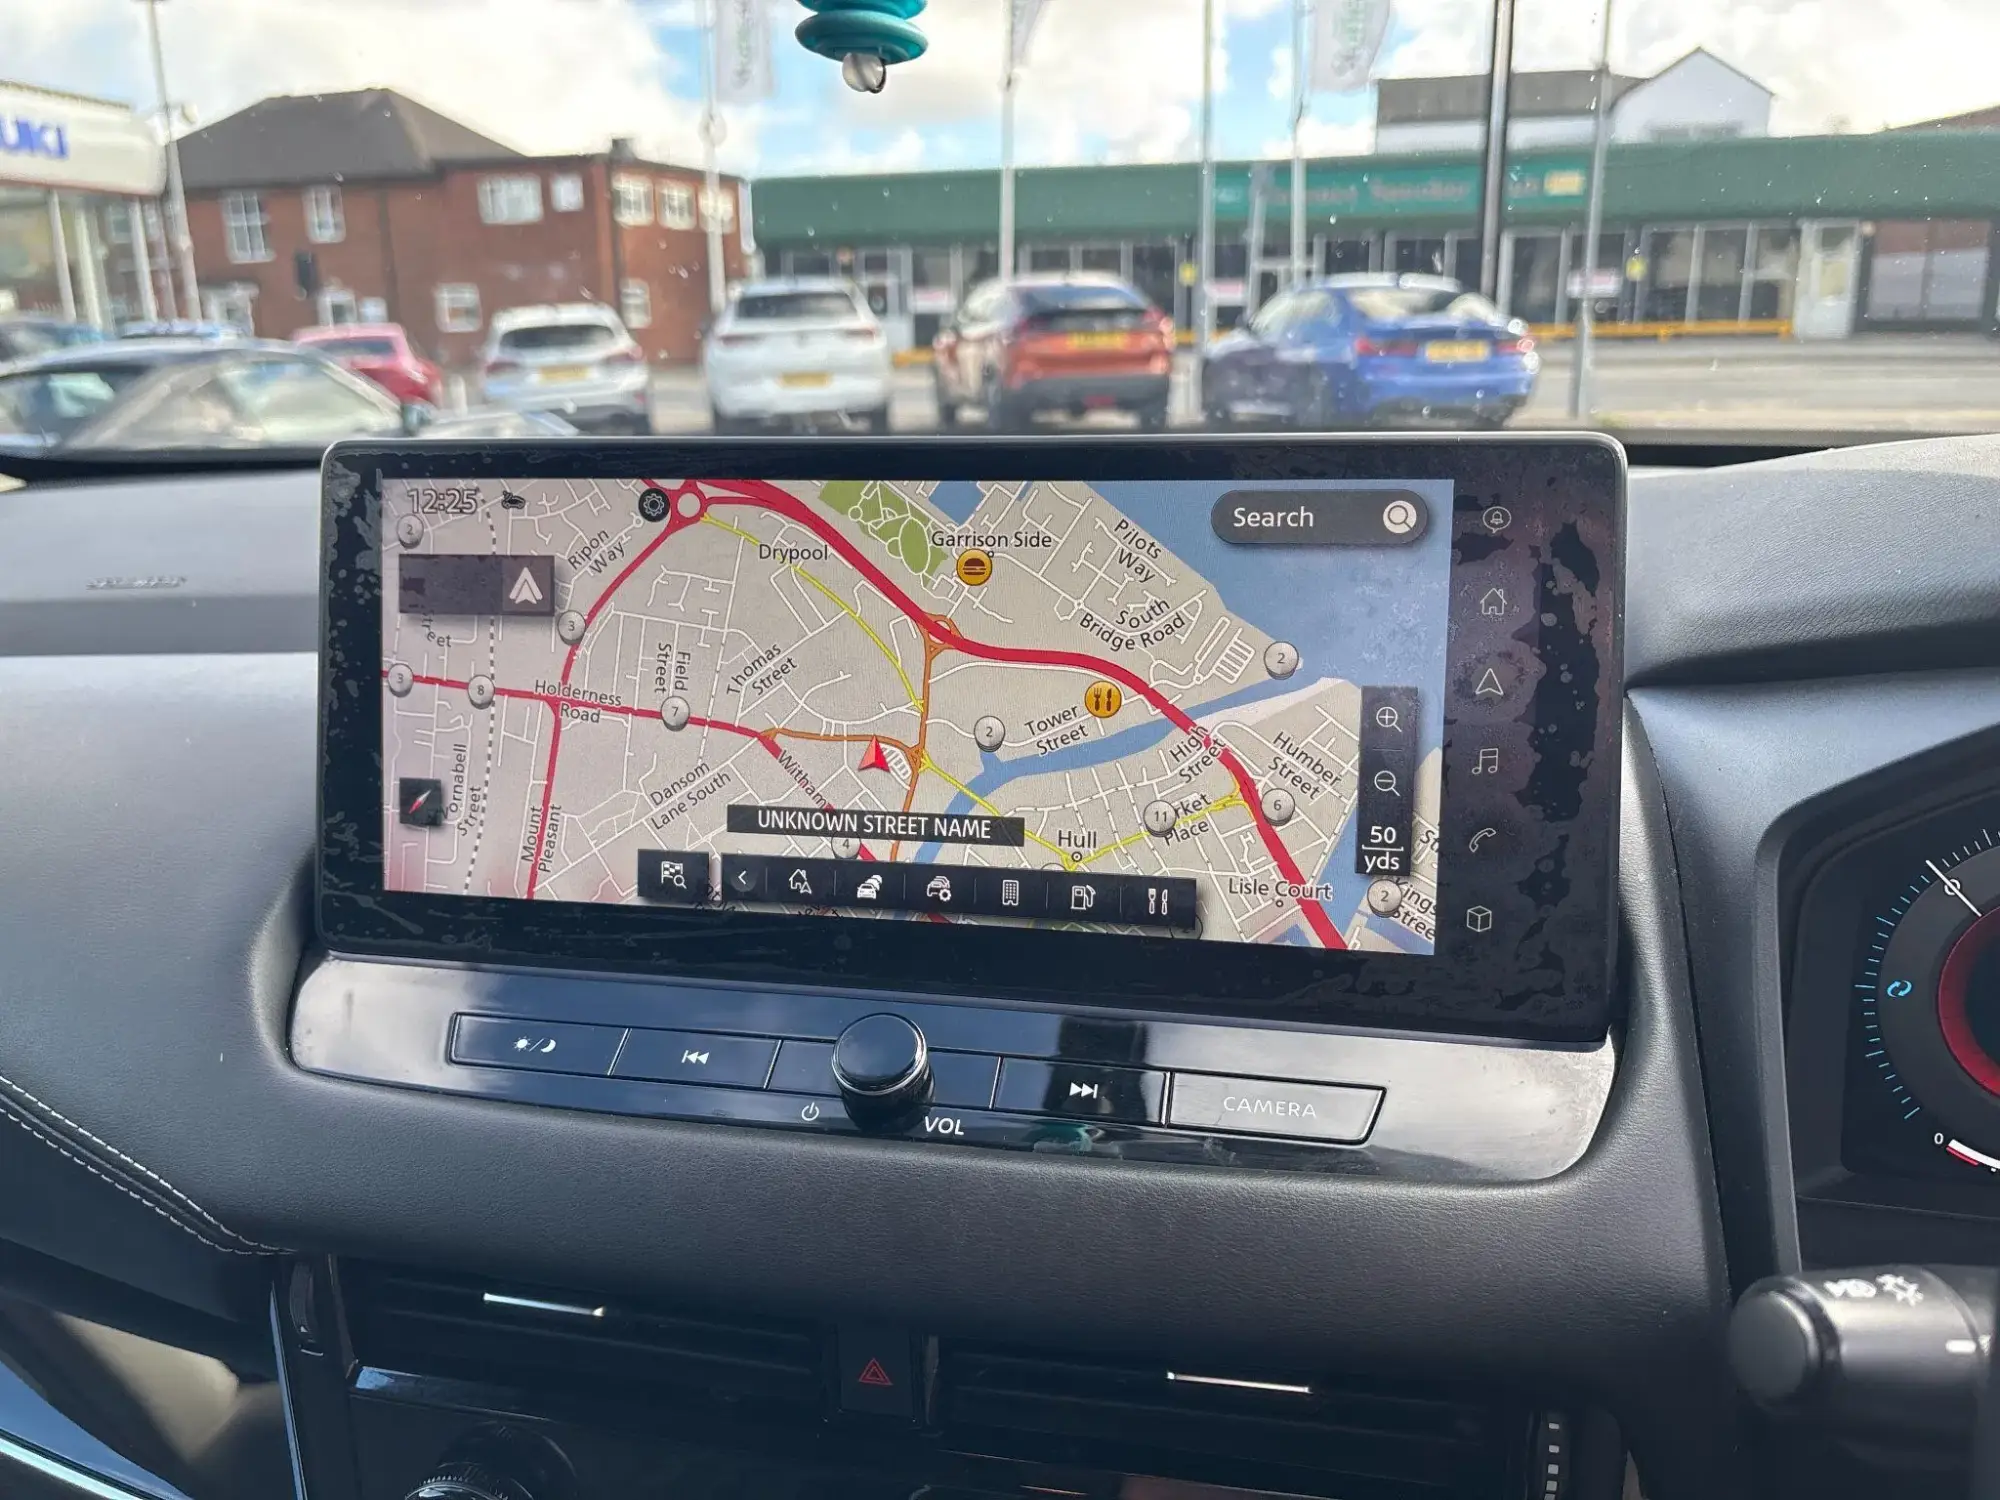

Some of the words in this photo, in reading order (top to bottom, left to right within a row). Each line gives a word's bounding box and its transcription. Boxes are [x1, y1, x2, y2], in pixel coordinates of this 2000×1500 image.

[407, 488, 477, 515] 12:25
[1233, 506, 1314, 527] Search
[568, 530, 609, 570] Ripon
[932, 530, 1008, 547] Garrison
[1014, 531, 1052, 547] Side
[1114, 519, 1162, 559] Pilots
[589, 542, 625, 574] Way
[759, 543, 828, 564] Drypool
[1117, 548, 1156, 583] Way
[568, 620, 575, 631] 3
[1115, 599, 1170, 629] South
[1080, 612, 1136, 652] Bridge
[1140, 612, 1185, 648] Road
[654, 643, 672, 694] Street
[674, 651, 691, 691] Field
[726, 644, 781, 695] Thomas
[1277, 652, 1285, 664] 2
[752, 657, 798, 695] Street
[535, 679, 622, 706] Holderness
[561, 703, 601, 723] Road
[672, 706, 679, 717] 7
[1024, 706, 1078, 736] Tower
[986, 726, 993, 737] 2
[1036, 724, 1089, 755] Street
[1169, 726, 1209, 763] High
[1179, 738, 1227, 784] Street
[1273, 731, 1342, 786] Humber
[650, 762, 710, 806] Dansom
[1268, 756, 1321, 800] Street
[457, 785, 482, 836] Street
[651, 802, 688, 830] Lane
[687, 772, 731, 806] South
[1274, 800, 1281, 811] 6
[758, 810, 857, 832] UNKNOWN
[863, 814, 928, 836] STREET
[934, 818, 991, 839] NAME
[1155, 811, 1167, 822] 11
[520, 805, 543, 862] Mount
[538, 804, 562, 873] Pleasant
[842, 838, 850, 849] 4
[1058, 830, 1097, 848] Hull
[1370, 825, 1397, 844] 50
[1364, 851, 1400, 873] yds
[1228, 878, 1269, 895] Lisle
[1275, 881, 1331, 899] Court
[1380, 890, 1389, 902] 2
[1223, 1096, 1317, 1119] CAMERA
[924, 1115, 965, 1136] VOL
[1934, 1132, 1944, 1145] 0
